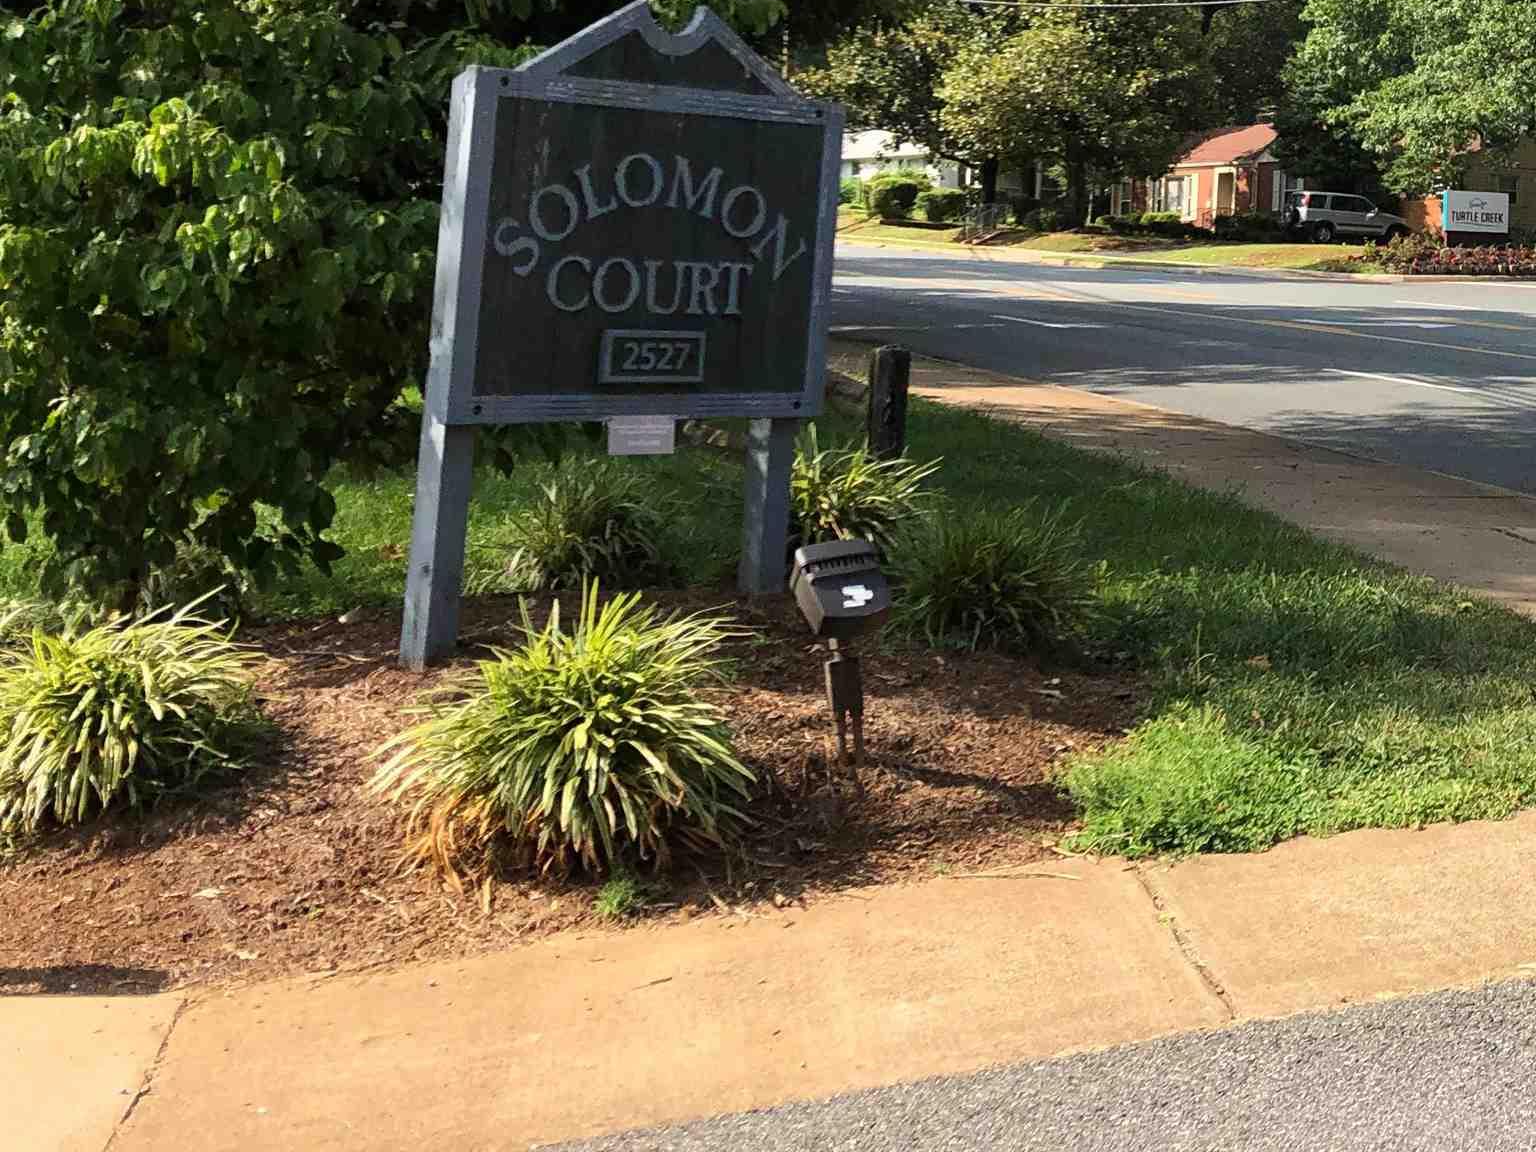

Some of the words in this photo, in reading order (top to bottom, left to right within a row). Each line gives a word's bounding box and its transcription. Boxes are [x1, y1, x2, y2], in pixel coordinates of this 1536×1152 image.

[494, 152, 807, 281] SOLOMON
[1452, 210, 1478, 224] TURTLE
[1480, 211, 1504, 224] CREEK
[546, 254, 755, 318] COURT
[622, 342, 691, 371] 2527
